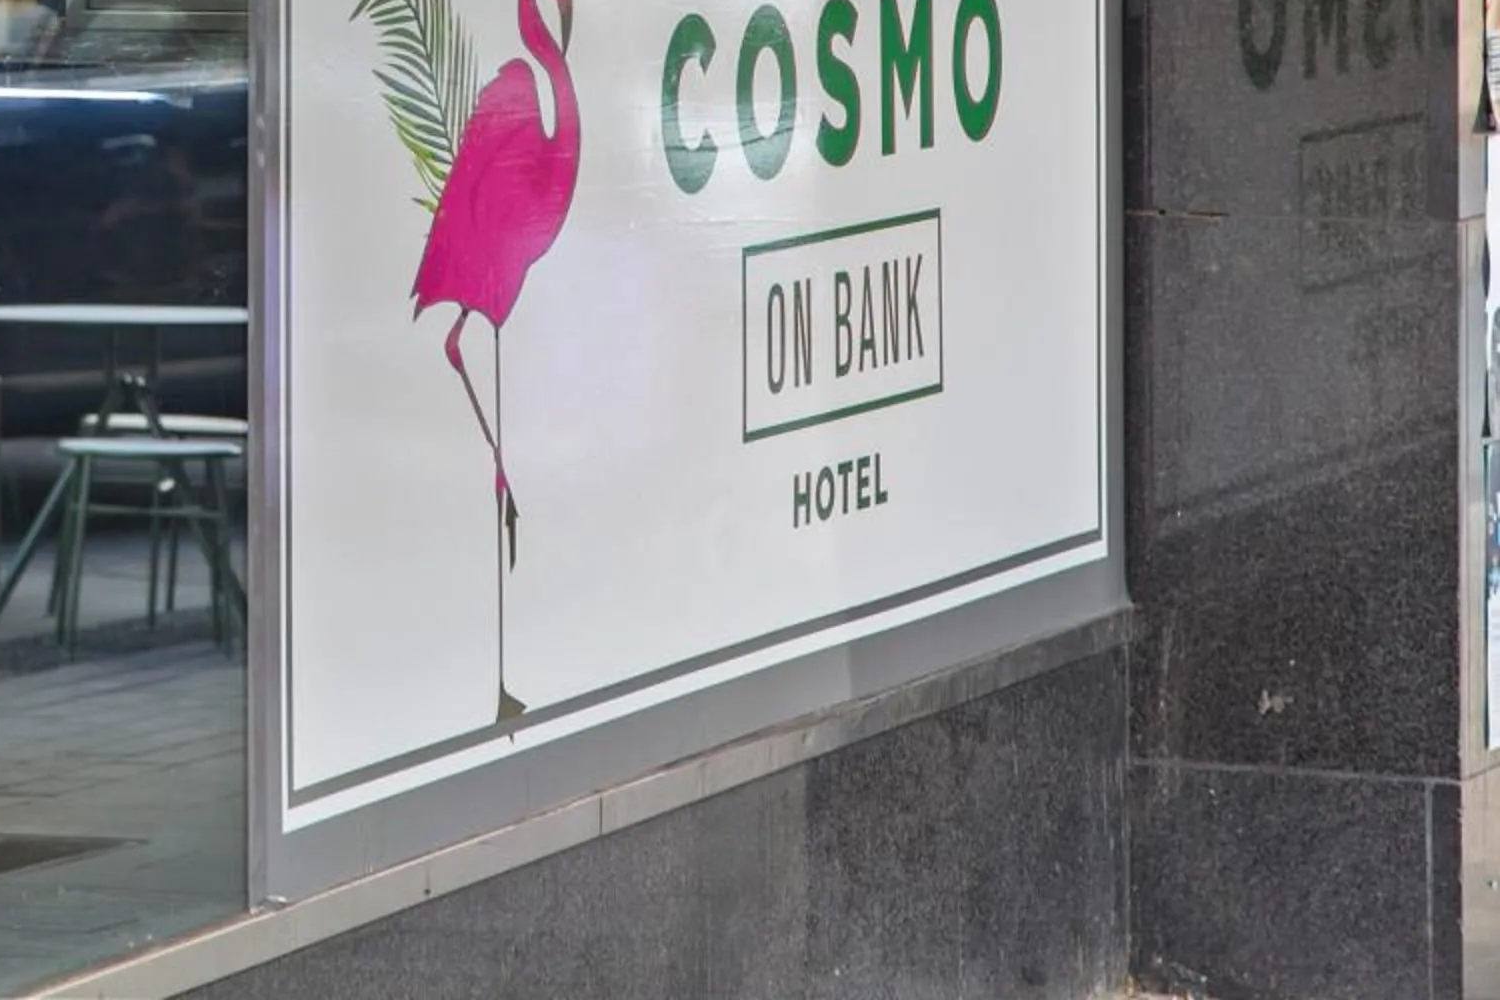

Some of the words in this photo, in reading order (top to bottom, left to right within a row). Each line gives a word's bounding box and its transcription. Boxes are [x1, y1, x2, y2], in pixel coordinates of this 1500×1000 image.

[767, 277, 813, 395] ON
[834, 253, 925, 379] BANK
[792, 452, 889, 529] HOTEL
